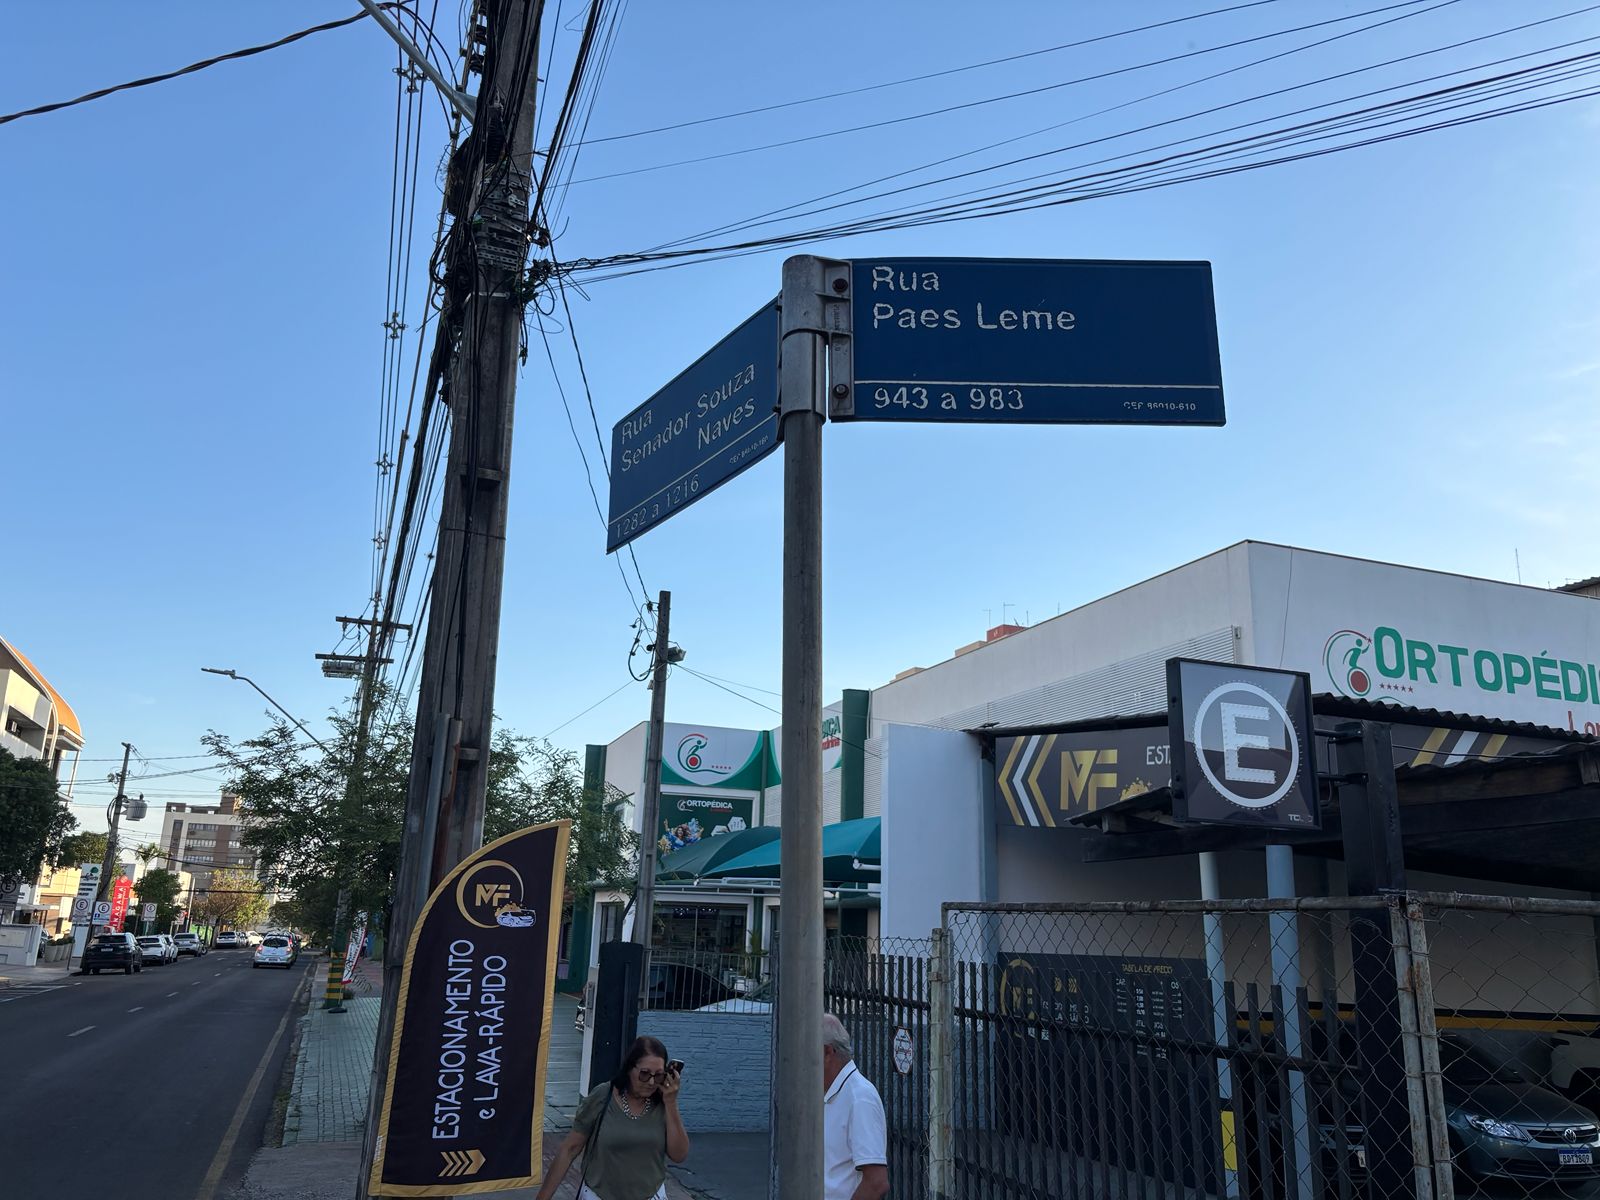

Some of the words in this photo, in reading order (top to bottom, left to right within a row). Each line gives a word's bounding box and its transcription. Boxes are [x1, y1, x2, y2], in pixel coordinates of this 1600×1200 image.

[872, 266, 940, 291] Rua
[873, 303, 961, 329] Paes
[977, 302, 1075, 330] Leme
[621, 411, 692, 472] Senador
[697, 363, 755, 418] Souza
[698, 398, 755, 450] Naves
[874, 387, 929, 409] 943
[941, 392, 957, 409] a
[969, 387, 1024, 410] 983
[621, 409, 652, 445] Rua
[617, 507, 647, 538] 1282
[651, 503, 659, 518] a
[666, 473, 699, 508] 1216
[1373, 626, 1600, 705] ORTOPÉDI
[1146, 745, 1171, 765] EST
[1220, 702, 1277, 785] E
[686, 799, 733, 809] ORTOPÉDICA
[1060, 749, 1118, 811] MF
[475, 884, 511, 906] MF
[431, 939, 475, 1141] ESTACIONAMENTO
[473, 955, 507, 1101] LAVA-RÁPIDO
